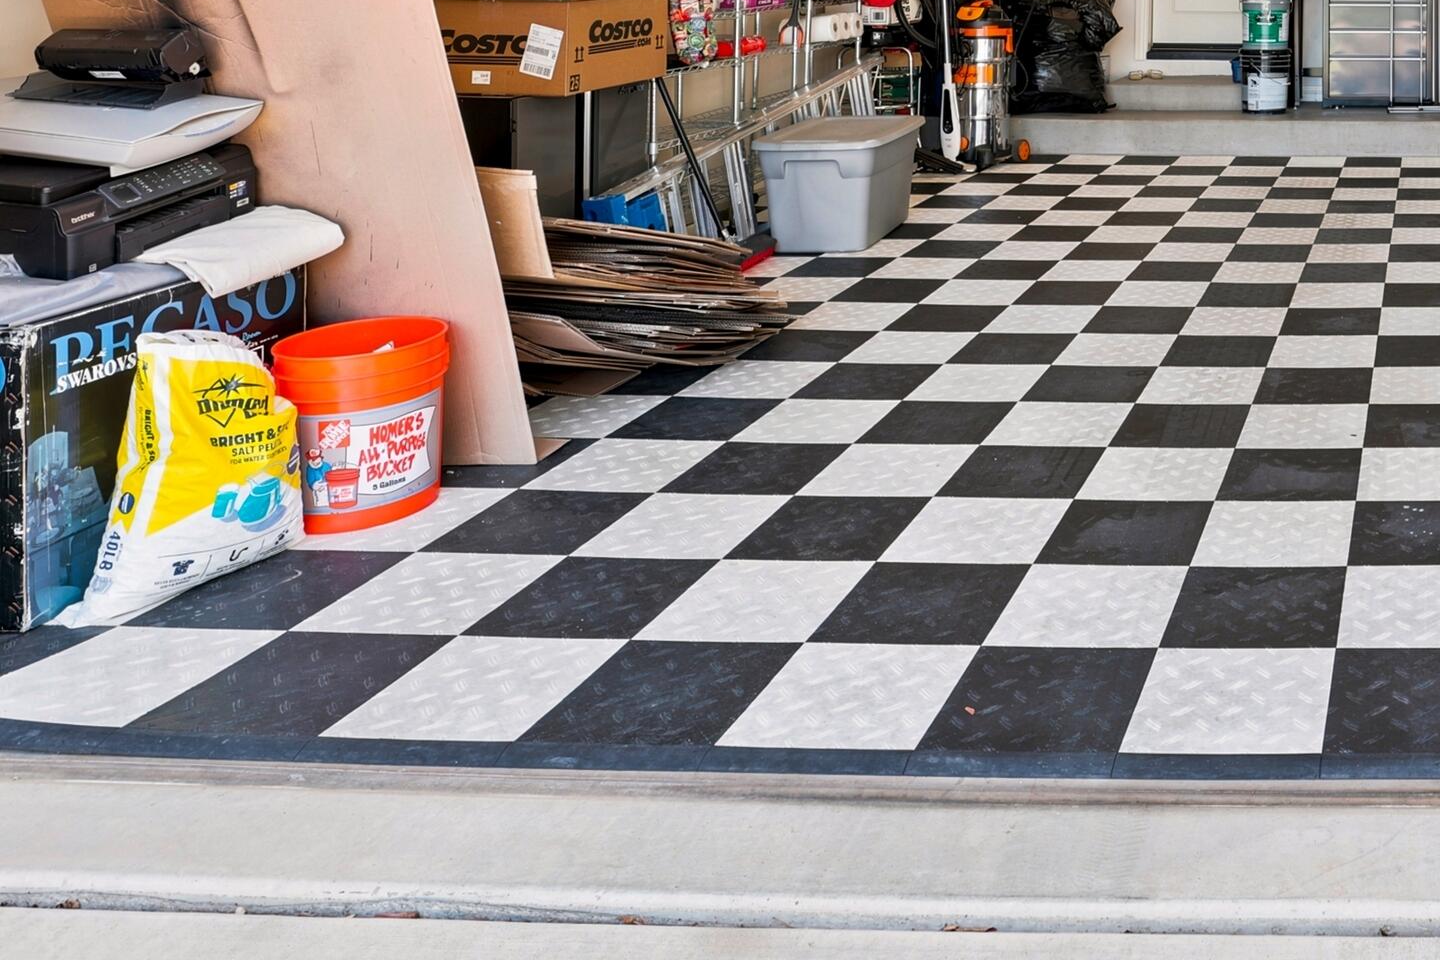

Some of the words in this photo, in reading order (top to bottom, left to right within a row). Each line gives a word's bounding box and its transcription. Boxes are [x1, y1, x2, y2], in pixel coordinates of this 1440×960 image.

[441, 29, 528, 54] COSTC
[589, 18, 653, 43] COSTCO
[71, 210, 96, 224] brother
[56, 352, 137, 394] SWAROVS
[210, 431, 264, 448] BRIGHT
[266, 428, 276, 440] &
[369, 411, 424, 447] HOMER'S
[232, 445, 254, 457] SALT
[366, 454, 415, 482] BUCKET
[380, 477, 407, 489] Gallons
